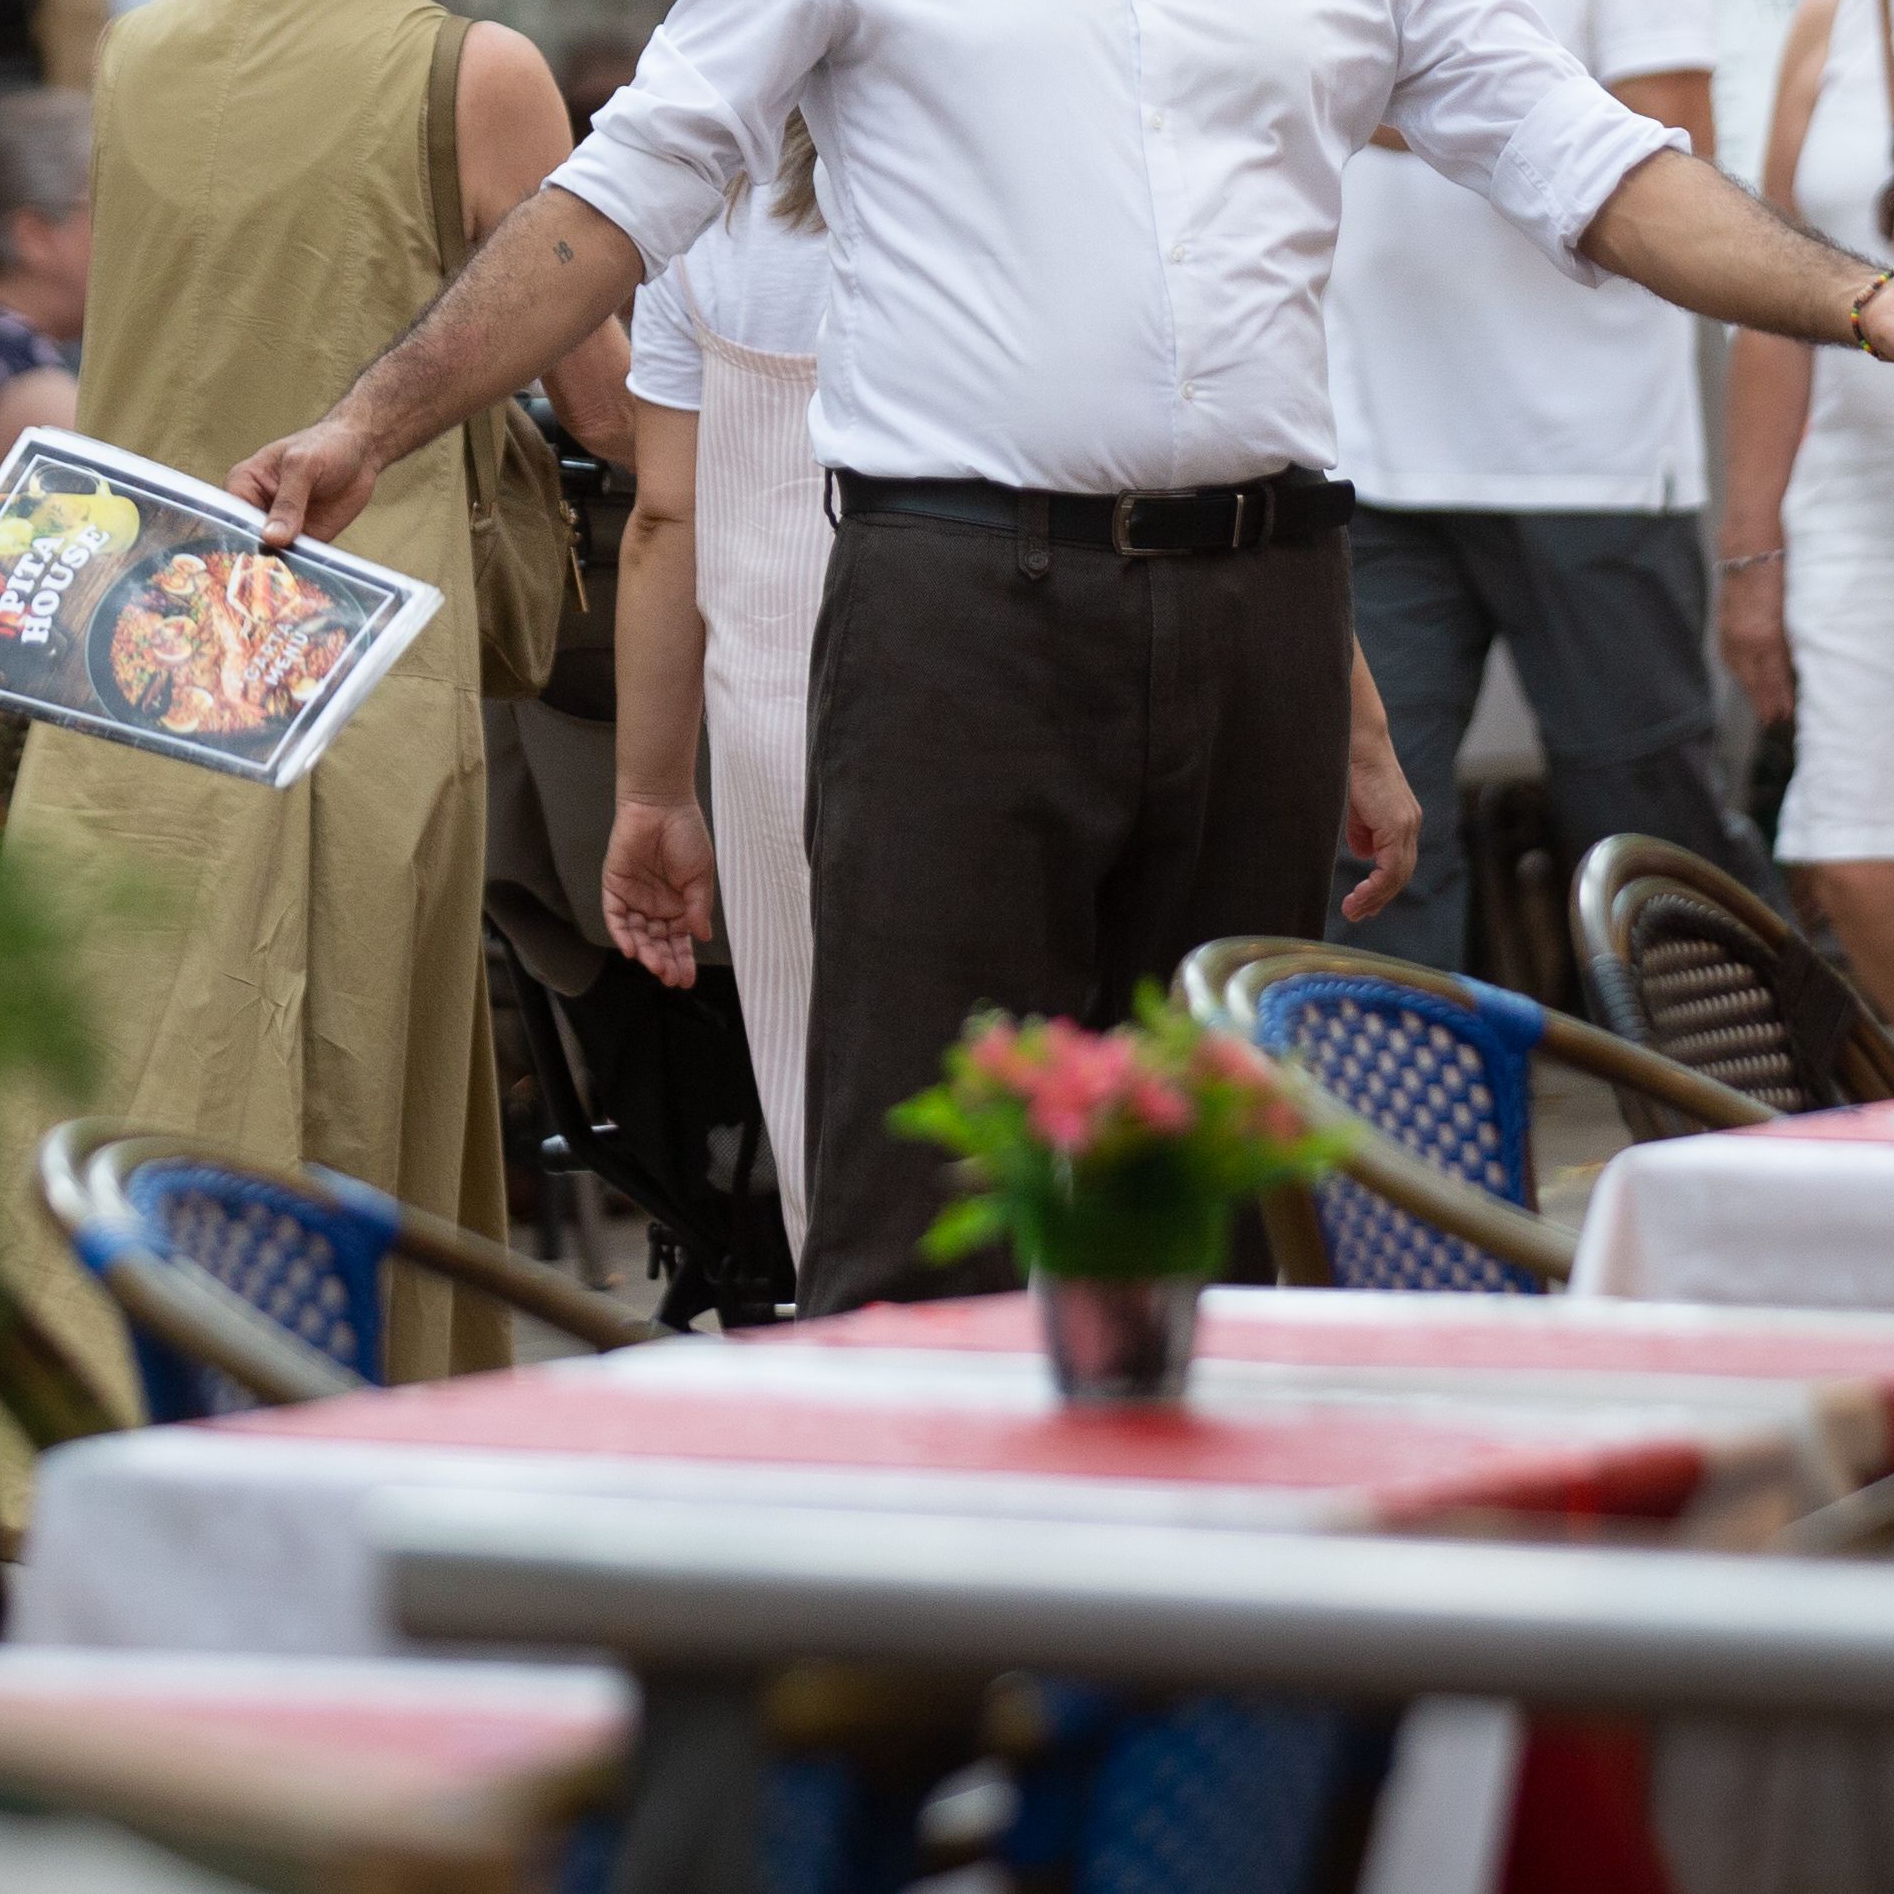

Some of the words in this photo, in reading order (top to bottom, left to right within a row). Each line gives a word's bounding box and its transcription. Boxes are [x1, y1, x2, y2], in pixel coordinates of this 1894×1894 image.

[20, 523, 110, 644] HOUSE
[244, 623, 294, 683] CARTA
[263, 630, 309, 686] MENU
